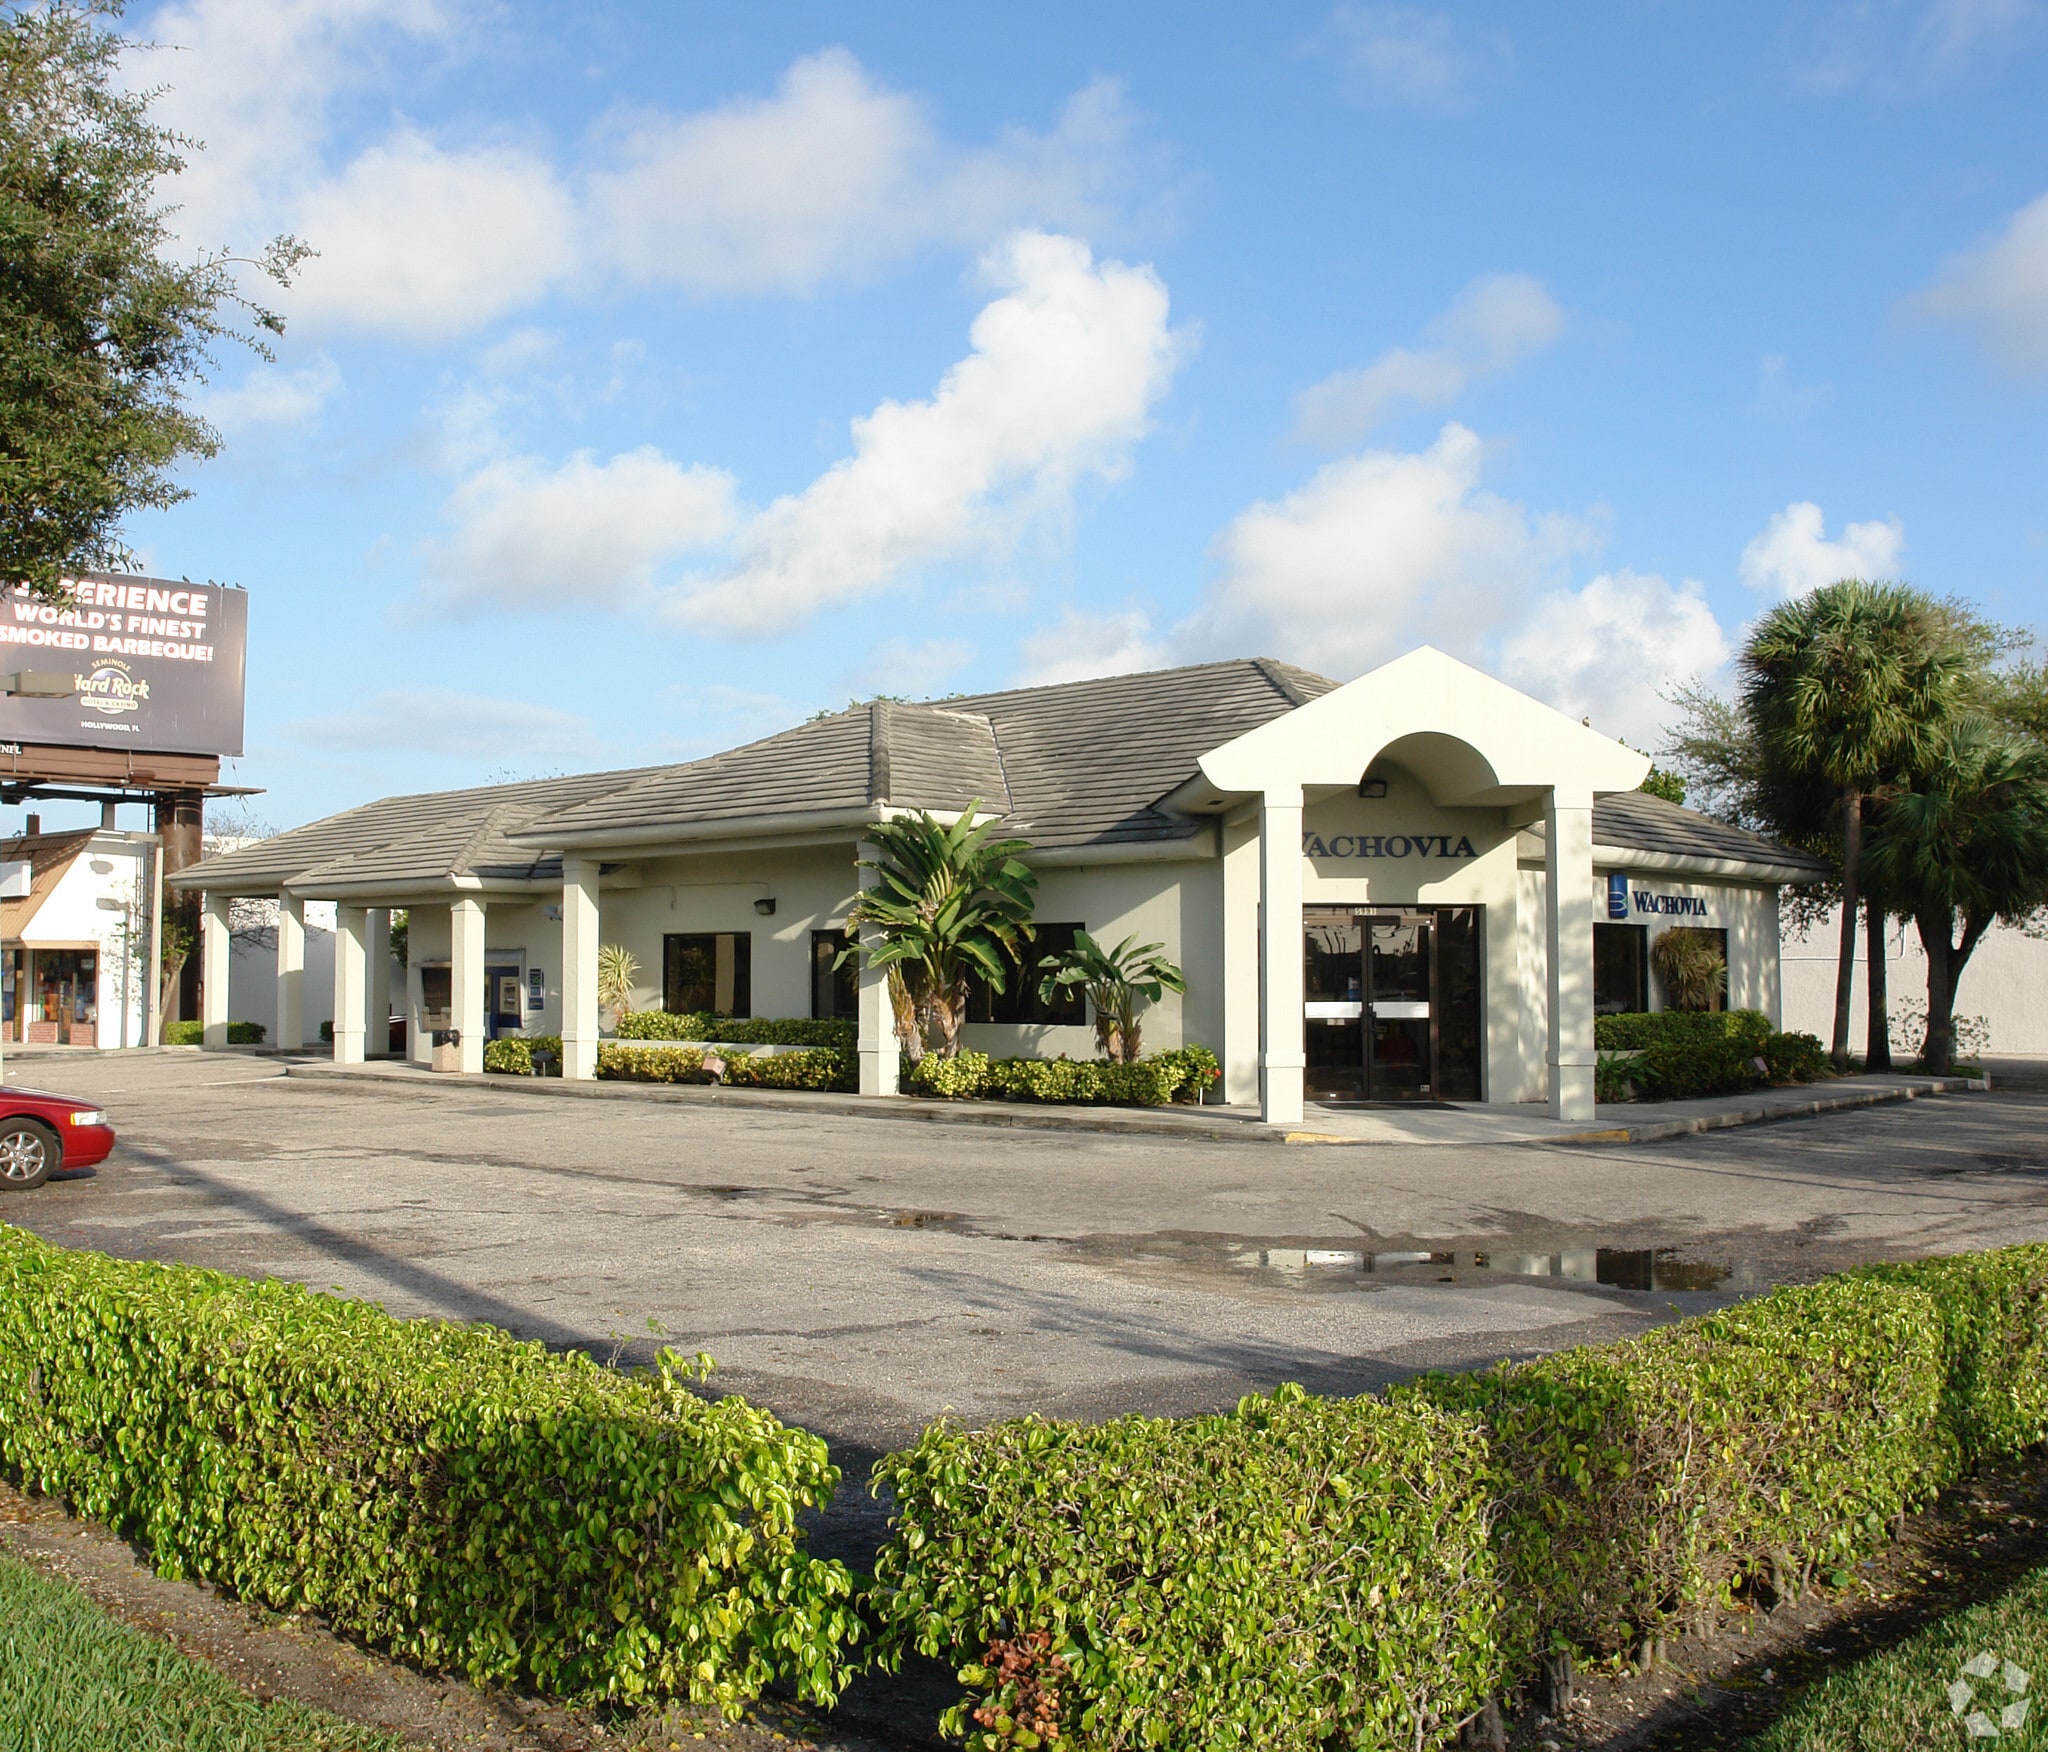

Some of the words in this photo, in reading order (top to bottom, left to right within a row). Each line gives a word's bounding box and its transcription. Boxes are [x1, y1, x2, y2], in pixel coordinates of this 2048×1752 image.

[13, 602, 122, 632] WORLD'S
[127, 615, 206, 639] FINEST
[0, 625, 89, 649] SMOKED
[93, 635, 213, 661] BARBEQUE!
[91, 658, 132, 672] SEMINOLE
[111, 677, 149, 699] Rock
[131, 724, 140, 732] FL
[1633, 891, 1707, 915] WACHOVIA
